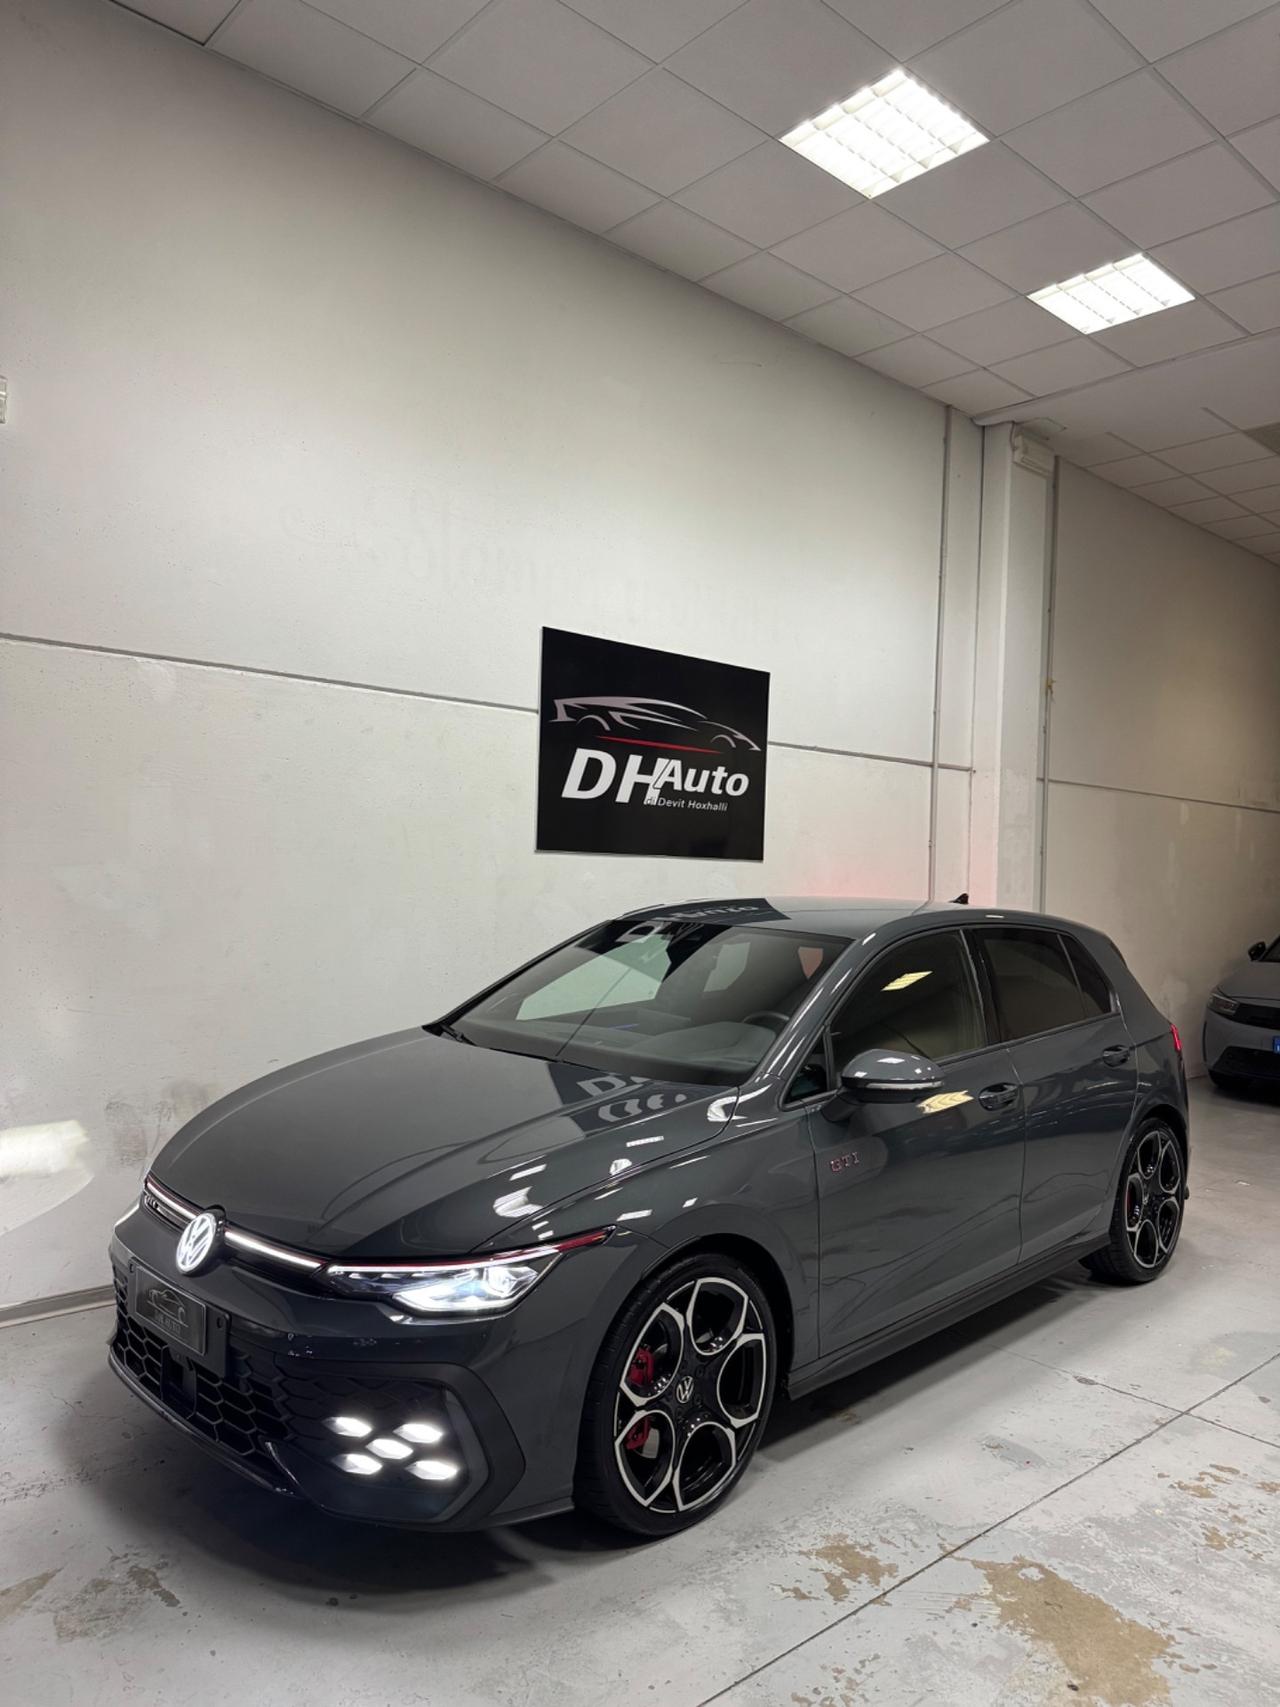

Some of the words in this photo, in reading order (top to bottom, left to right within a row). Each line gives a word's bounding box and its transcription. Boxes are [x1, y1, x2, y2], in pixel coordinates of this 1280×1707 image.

[657, 797, 686, 808] Devit
[687, 799, 729, 812] Hoxhalli
[830, 1152, 860, 1173] GTI
